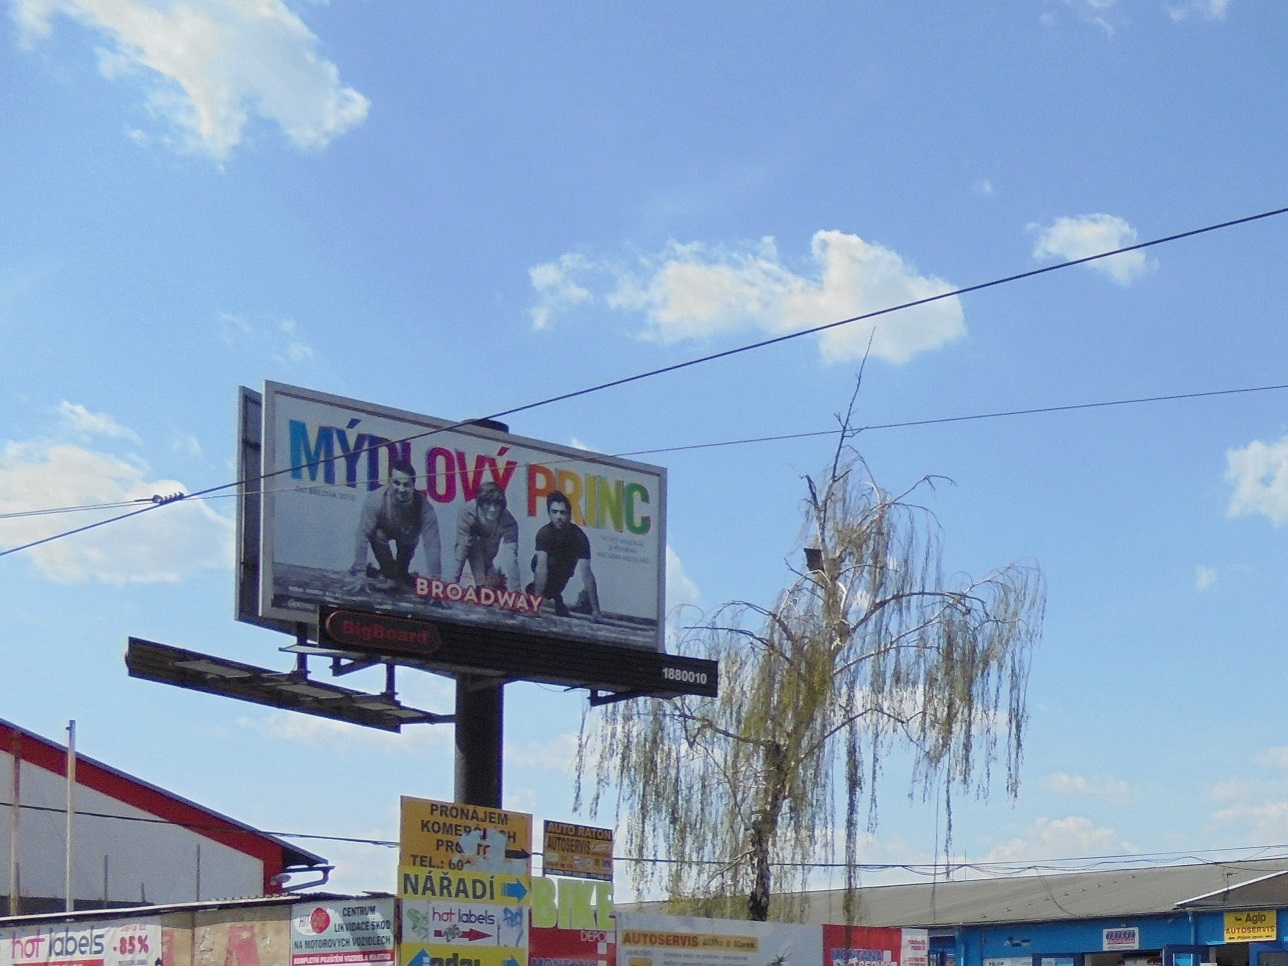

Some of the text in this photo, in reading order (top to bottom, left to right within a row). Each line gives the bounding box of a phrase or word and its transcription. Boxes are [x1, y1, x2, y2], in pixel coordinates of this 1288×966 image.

[527, 464, 651, 535] PRINC
[416, 577, 543, 612] BROADWAY
[343, 619, 429, 644] BigBoard
[662, 666, 708, 686] 1880010
[430, 803, 509, 826] PRONÁJEM
[547, 822, 576, 836] AUTO
[410, 854, 444, 869] TEL.:
[403, 870, 496, 900] NÁŘADÍ
[343, 905, 376, 917] CENTRUM
[531, 877, 616, 931] BIKE
[432, 907, 495, 925] hot labels
[1245, 912, 1267, 924] Agip
[334, 921, 370, 933] LIKVIDACE
[1226, 926, 1275, 935] AUTOSERVIS
[11, 929, 45, 959] hot
[48, 926, 104, 957] labels
[294, 935, 391, 950] NA MOTOROVÝCH VOZIDLECH
[580, 930, 606, 942] DEPO
[623, 933, 699, 947] AUTOSERVIS
